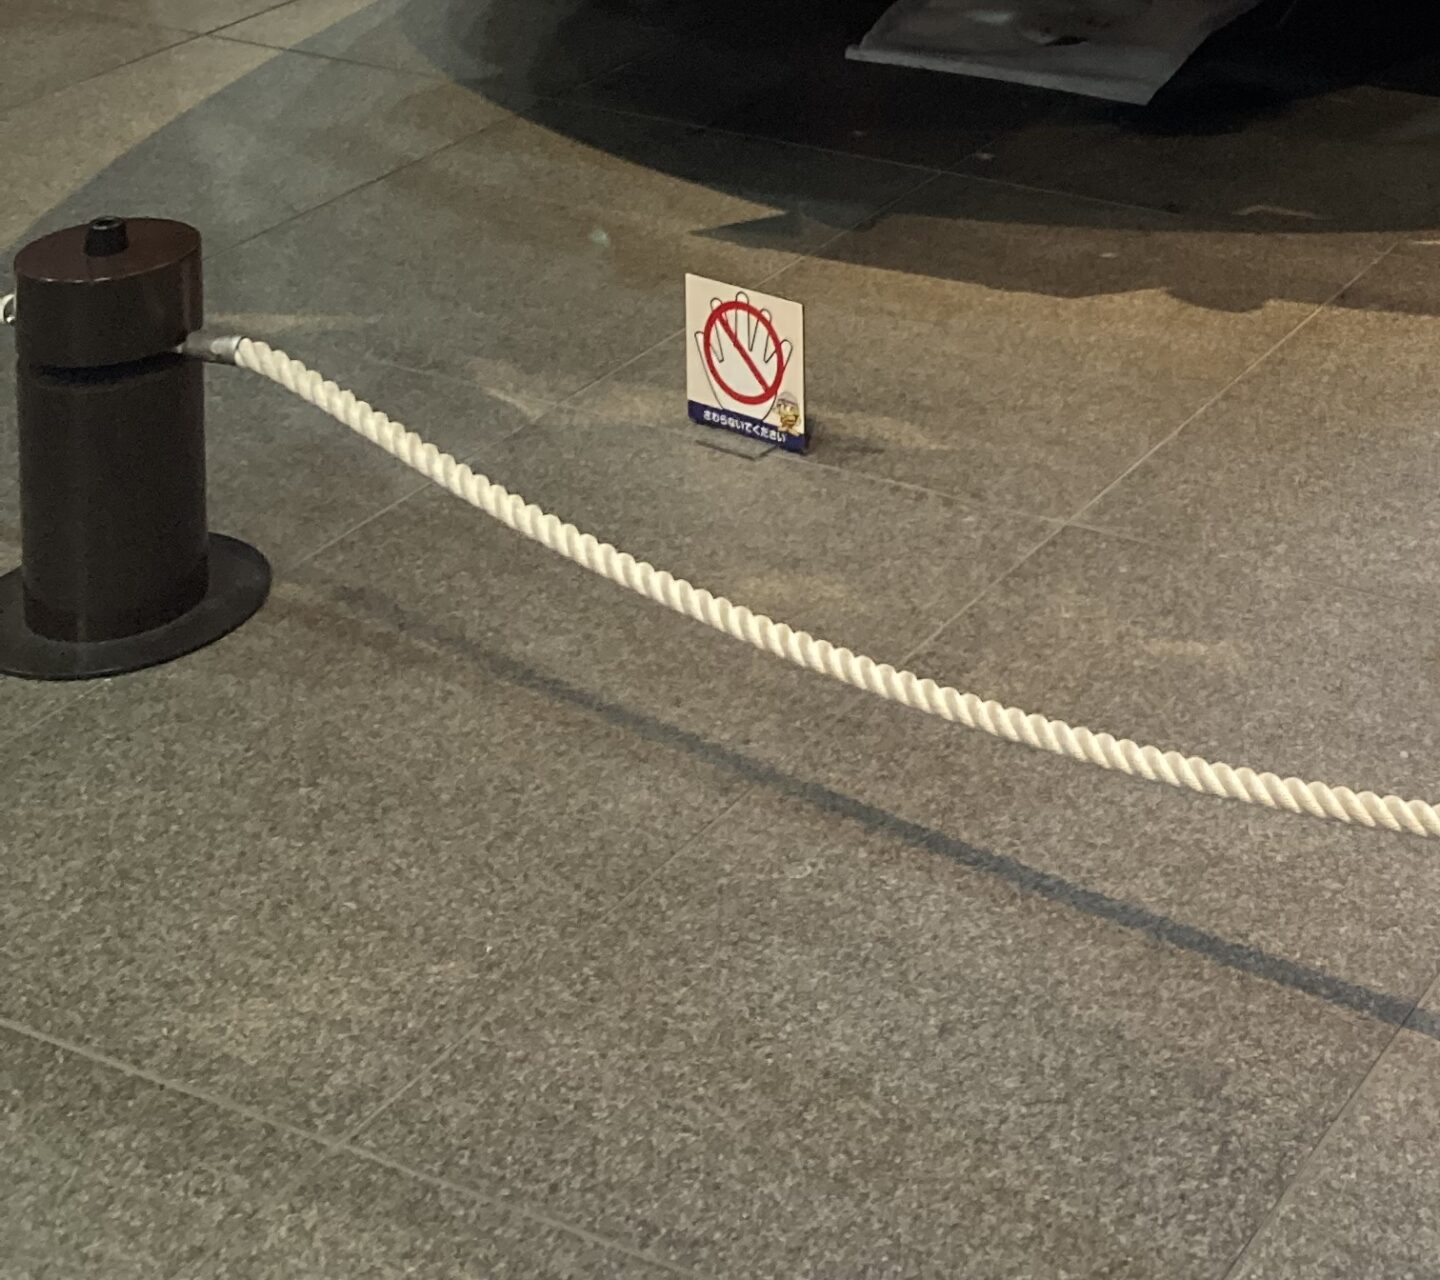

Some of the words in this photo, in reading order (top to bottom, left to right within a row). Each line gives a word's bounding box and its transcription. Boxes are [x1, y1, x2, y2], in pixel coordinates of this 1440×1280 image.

[702, 409, 787, 443] さわらないでください
